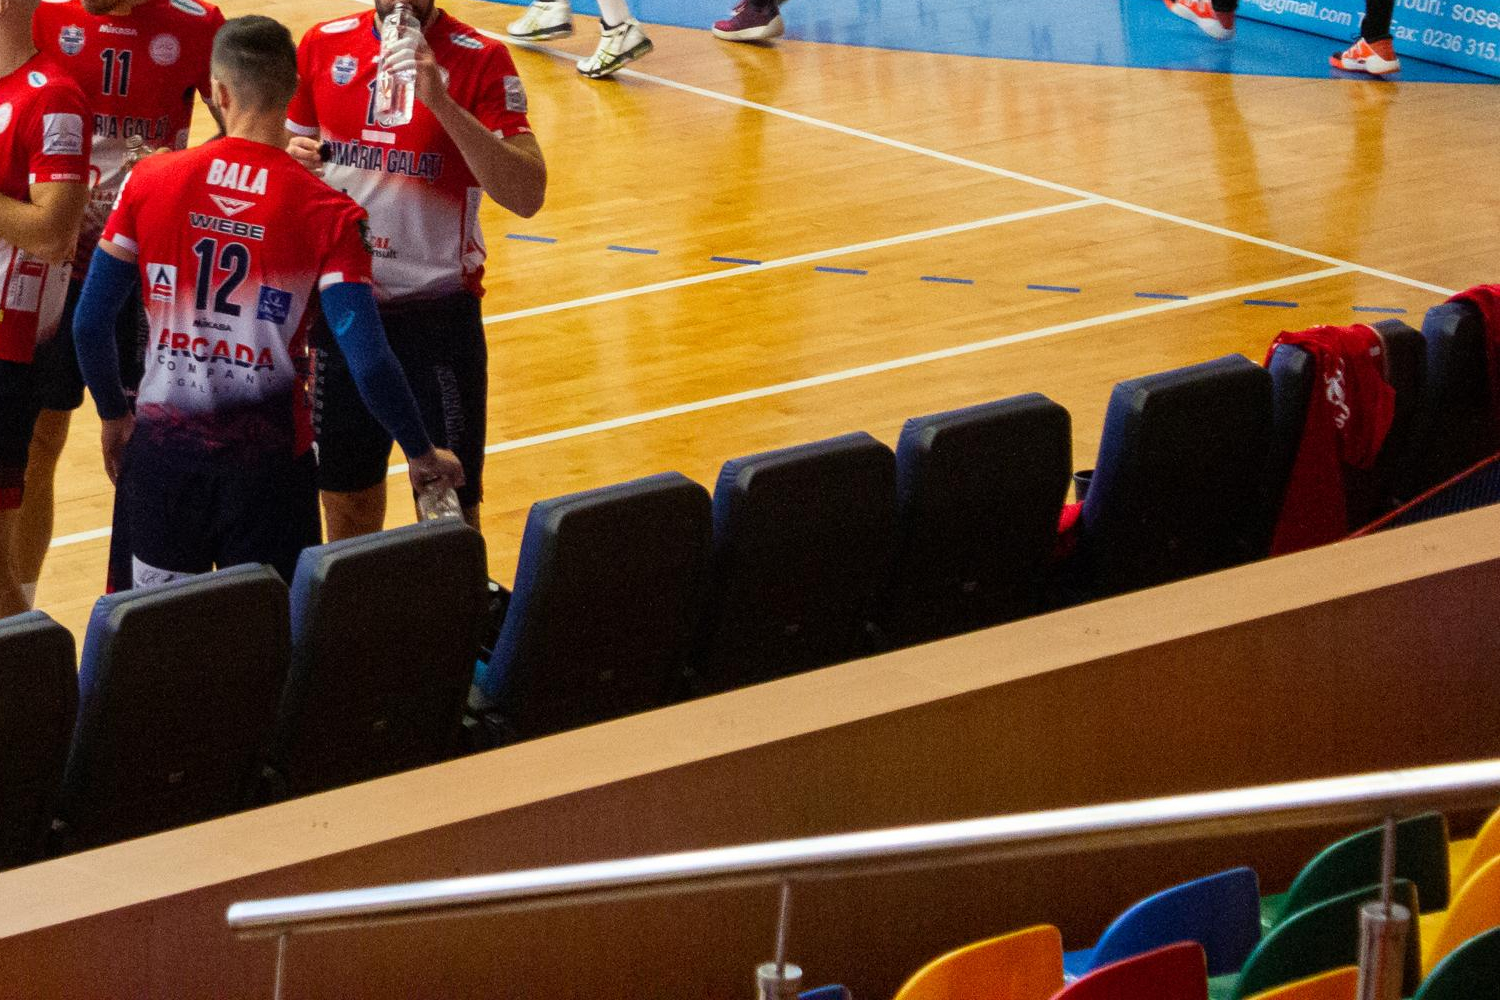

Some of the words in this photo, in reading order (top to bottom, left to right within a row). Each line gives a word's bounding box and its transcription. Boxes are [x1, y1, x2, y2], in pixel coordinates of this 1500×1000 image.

[1451, 3, 1500, 30] sose
[1422, 28, 1463, 52] 0236
[100, 47, 133, 97] 11
[205, 158, 269, 195] BALA
[188, 211, 266, 241] WIEBE
[192, 236, 250, 318] 12
[157, 327, 274, 373] ARCADA
